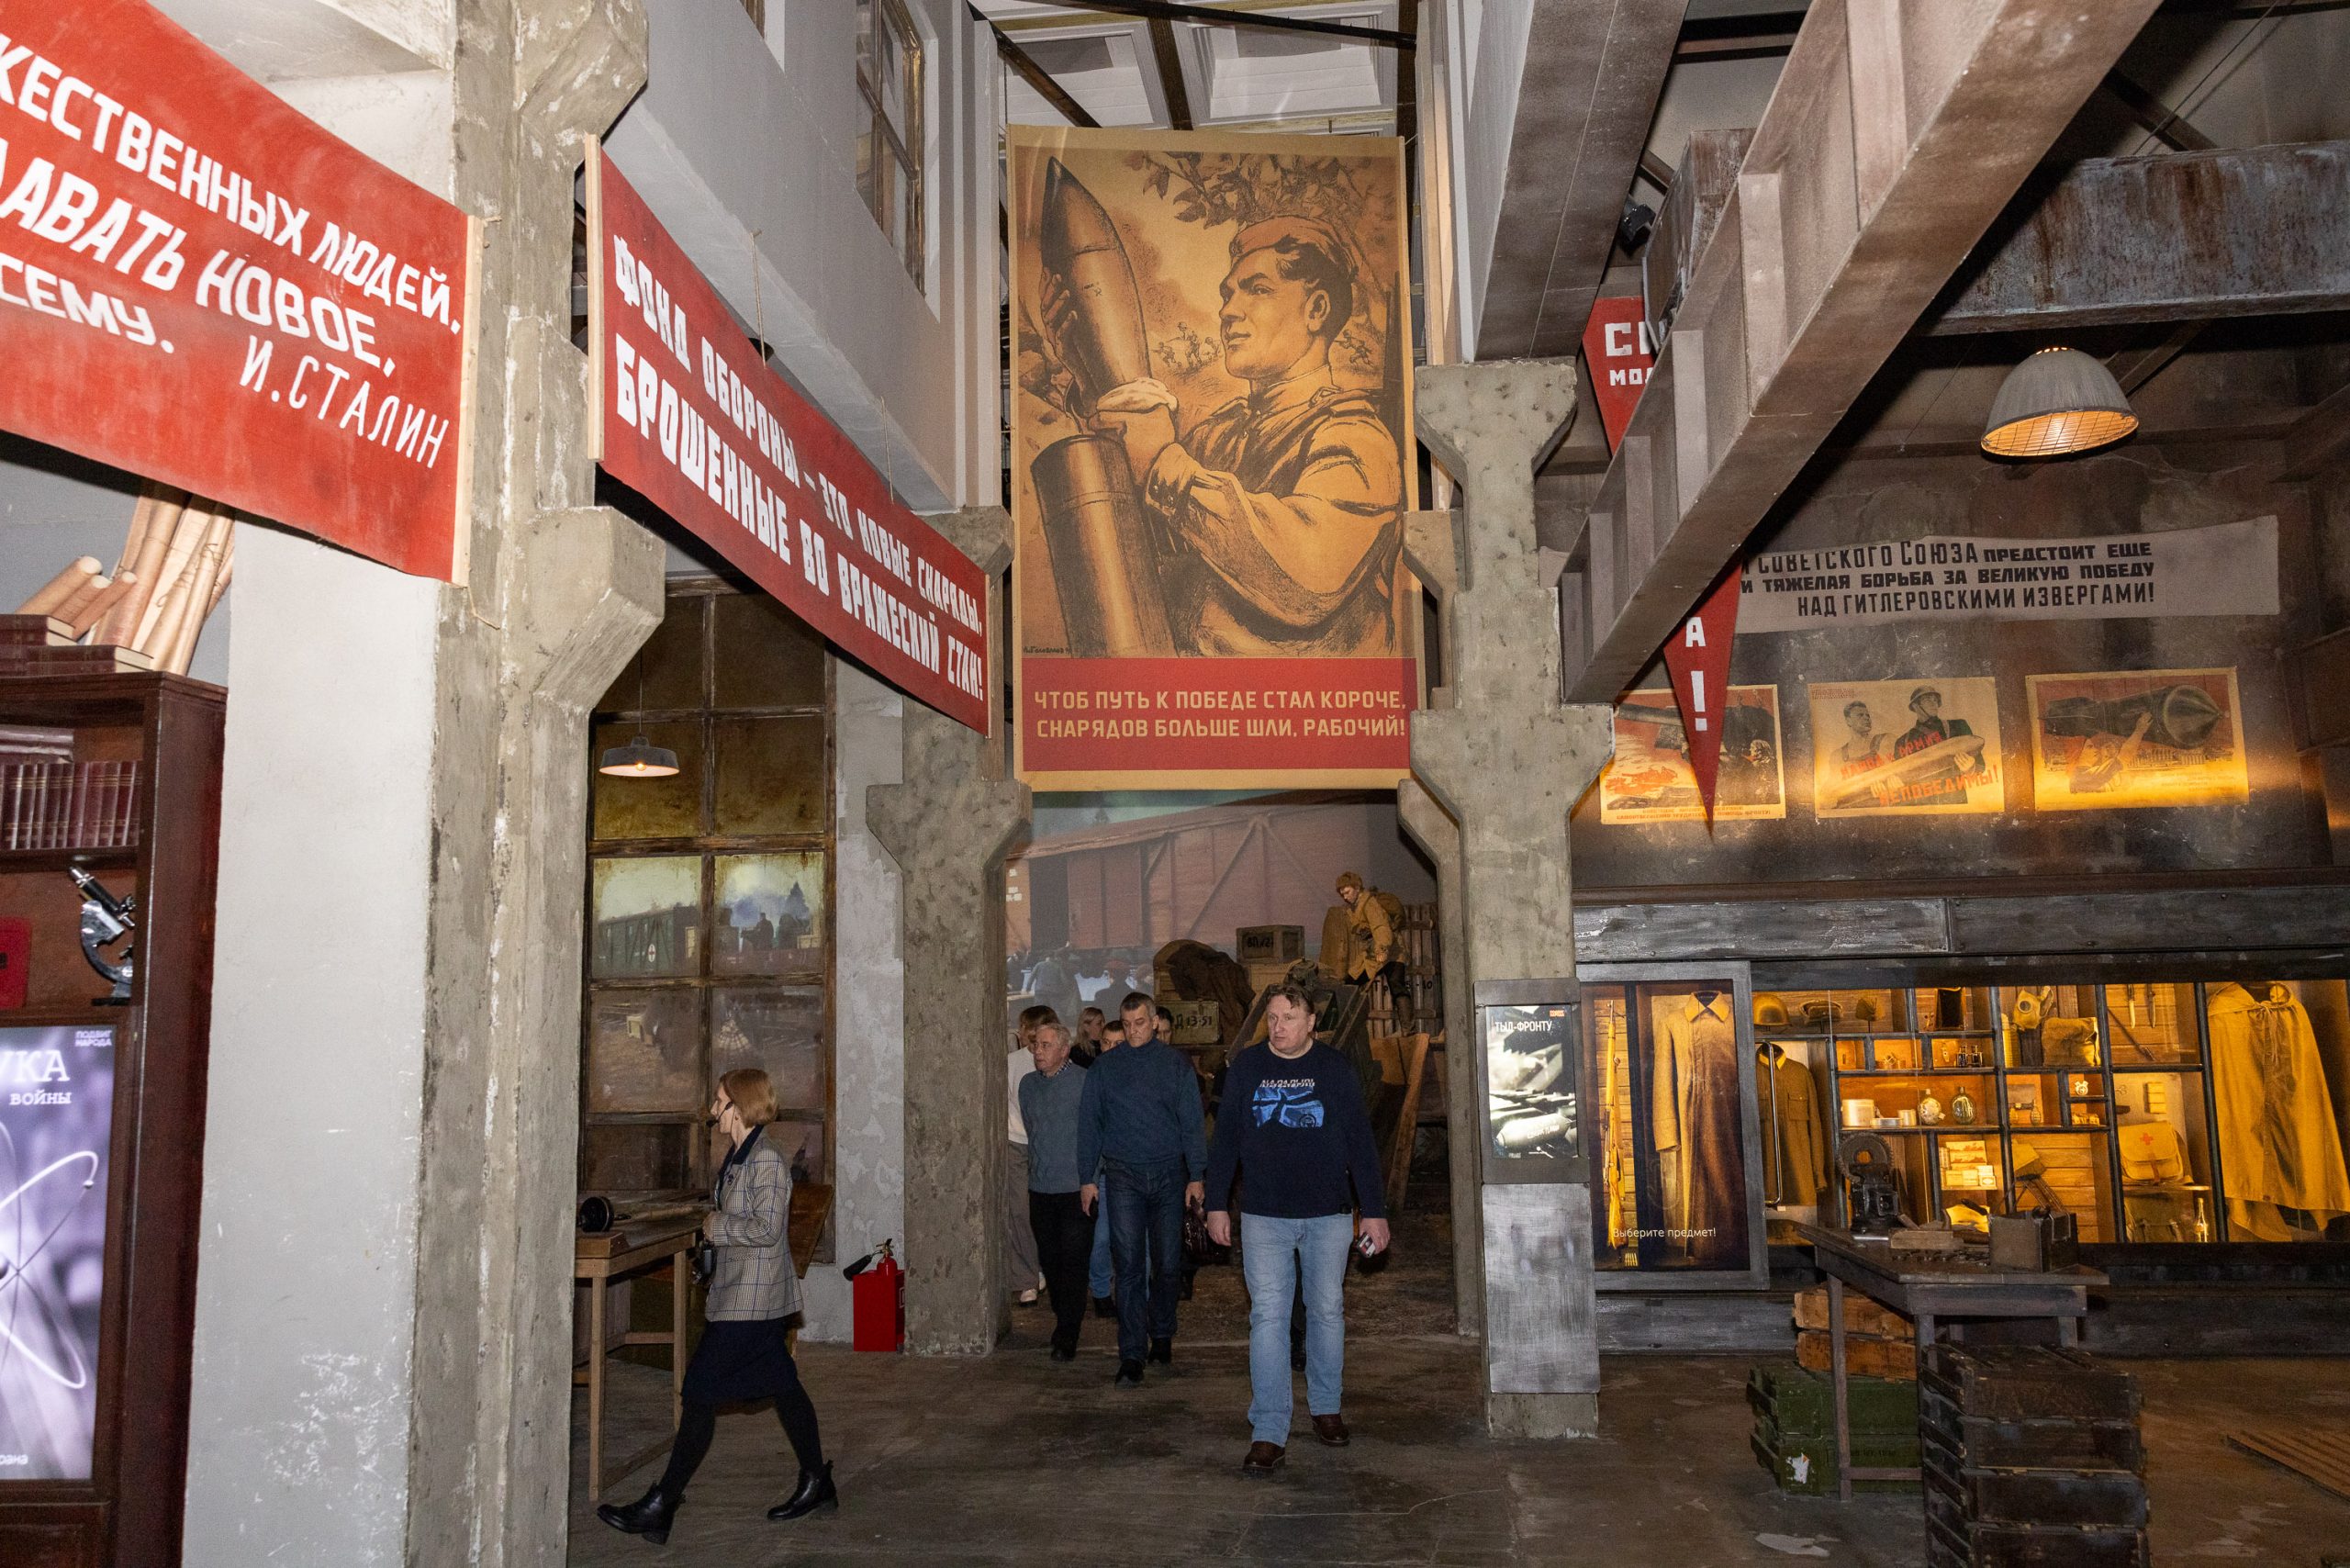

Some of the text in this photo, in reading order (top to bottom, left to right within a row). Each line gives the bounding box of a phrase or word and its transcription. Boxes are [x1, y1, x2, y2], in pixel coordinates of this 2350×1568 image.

[0, 138, 187, 291] АВАТЬ
[614, 234, 691, 374] ФОНД
[701, 336, 800, 488] ОБОРОНЫ
[819, 472, 854, 541] ЭТО
[857, 508, 912, 588] НОВЫЕ
[917, 556, 982, 637] СНАРЯДЫ,
[616, 332, 983, 701] БРОШЕННЫЕ ВО ВРАЖЕСКИЙ СТАН!
[1983, 544, 2096, 564] ПРЕДСТОИТ
[2107, 542, 2153, 559] ЕЩЕ
[1762, 575, 1851, 593] ТЯЖЕЛАЯ
[1861, 570, 1934, 589] БОРЬБА
[1943, 569, 1967, 585] ЗА
[1977, 566, 2069, 584] ВЕЛИКУЮ
[2080, 562, 2155, 579] ПОБЕДУ
[1797, 582, 2155, 618] НАД ГИТЛЕРОВСКИМИ ИЗВЕРГАМИ!
[1035, 690, 1406, 711] ЧТОБ ПУТЬ К ПОБЕДЕ СТАЛ КОРОЧЕ,
[1036, 714, 1405, 740] СНАРЯДОВ БОЛЬШЕ ШЛИ, РАБОЧИЙ!
[1878, 764, 1999, 806] НЕПОБЕДИМЫ!
[9, 1089, 73, 1105] ВОЙНЫ
[1613, 1227, 1717, 1240] Выберите предмет!
